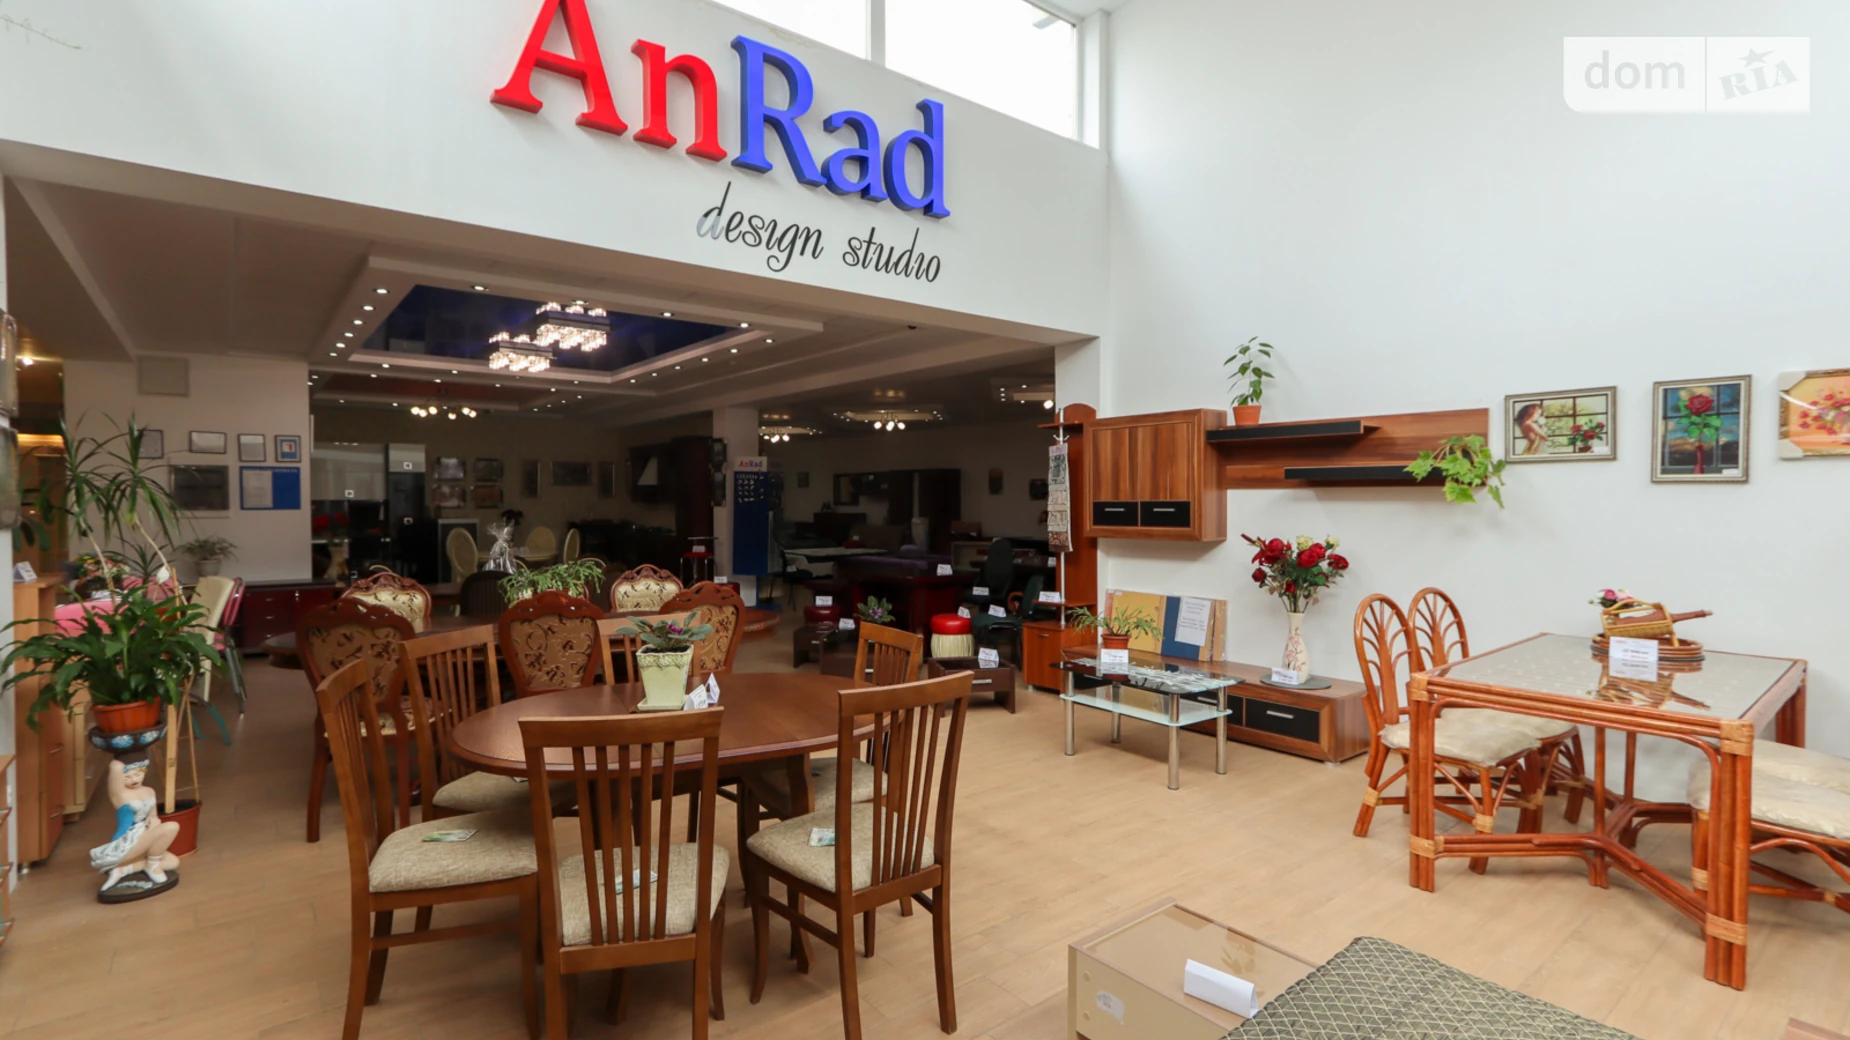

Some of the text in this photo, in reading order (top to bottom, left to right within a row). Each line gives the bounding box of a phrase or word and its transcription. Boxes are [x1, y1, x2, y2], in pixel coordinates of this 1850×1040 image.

[490, 0, 951, 219] AnRad
[696, 181, 942, 283] design studio
[739, 460, 763, 468] AnRad
